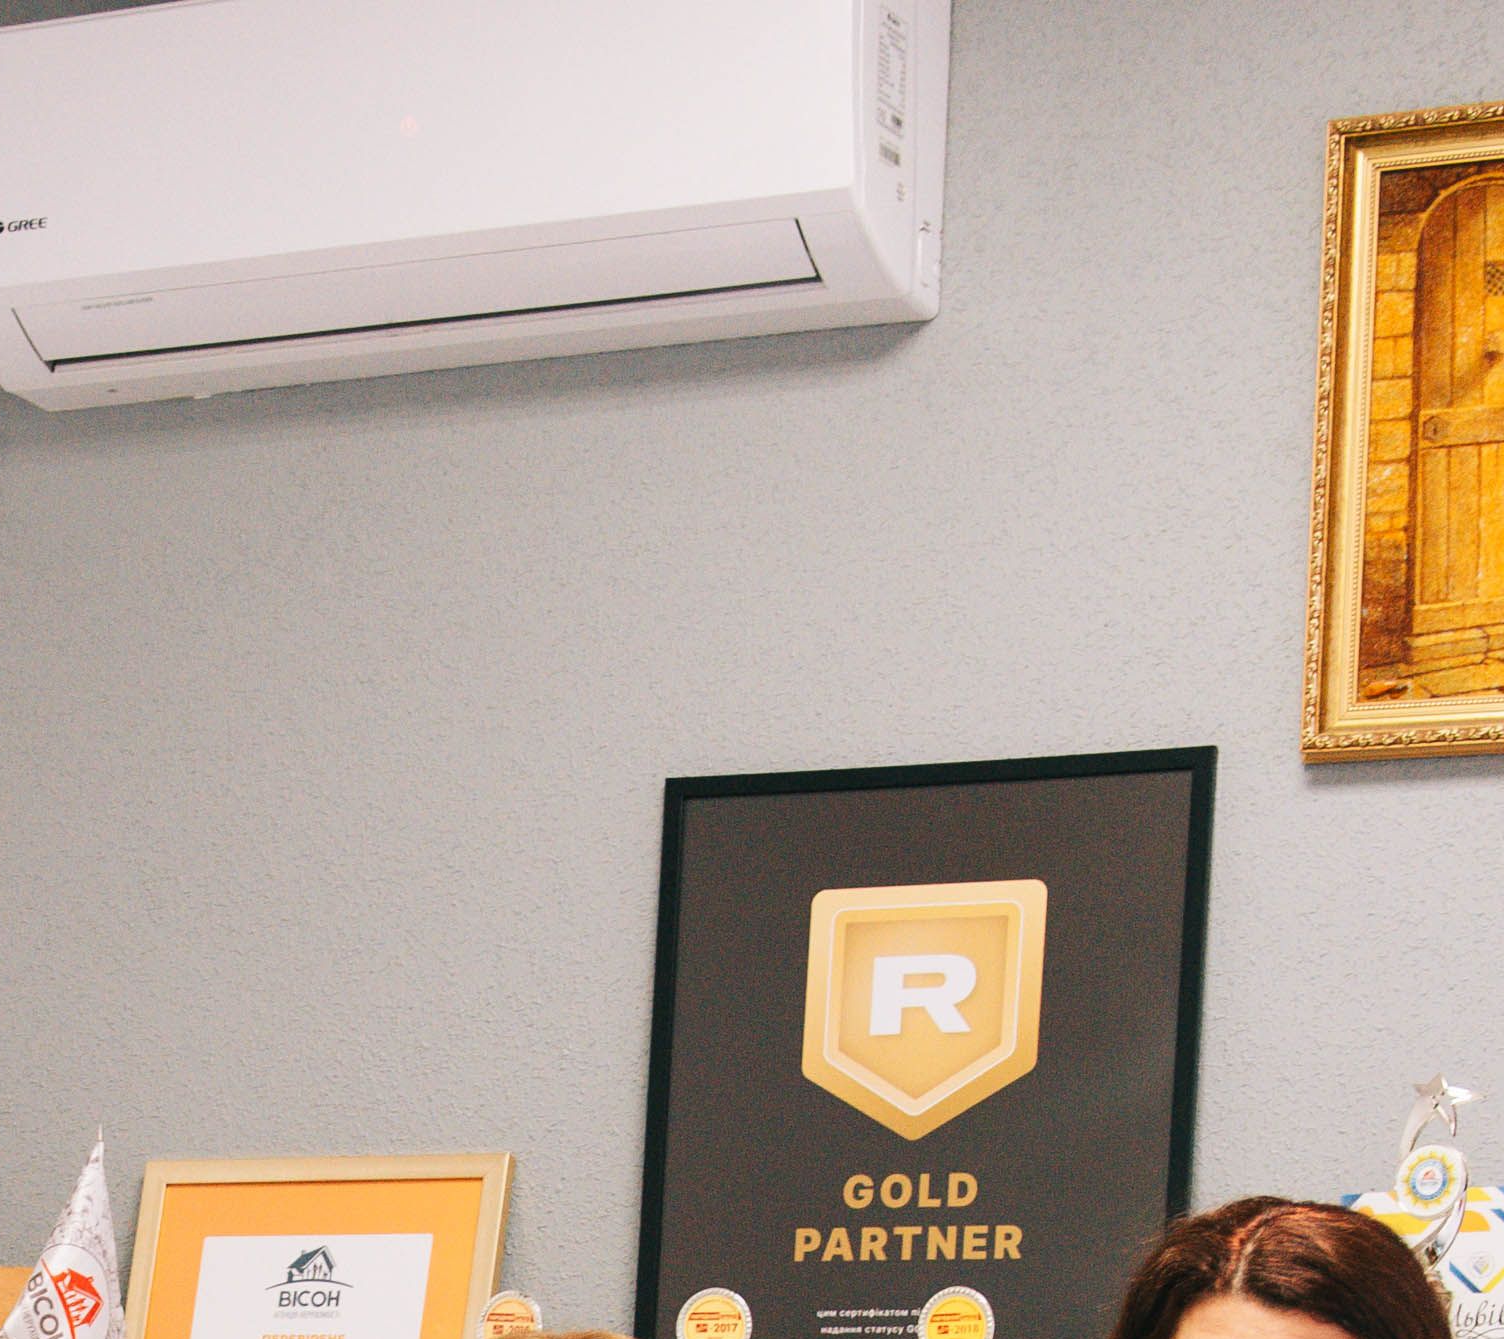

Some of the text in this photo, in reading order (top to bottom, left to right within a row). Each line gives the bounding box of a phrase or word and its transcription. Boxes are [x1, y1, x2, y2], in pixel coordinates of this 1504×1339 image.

[8, 217, 48, 232] GREE
[869, 954, 977, 1036] R
[843, 1172, 978, 1209] GOLD
[793, 1224, 1023, 1263] PARTNER
[278, 1290, 340, 1308] ВІСОН
[839, 1307, 908, 1319] сертифікатом
[714, 1323, 738, 1333] 2017
[864, 1326, 904, 1336] статусу
